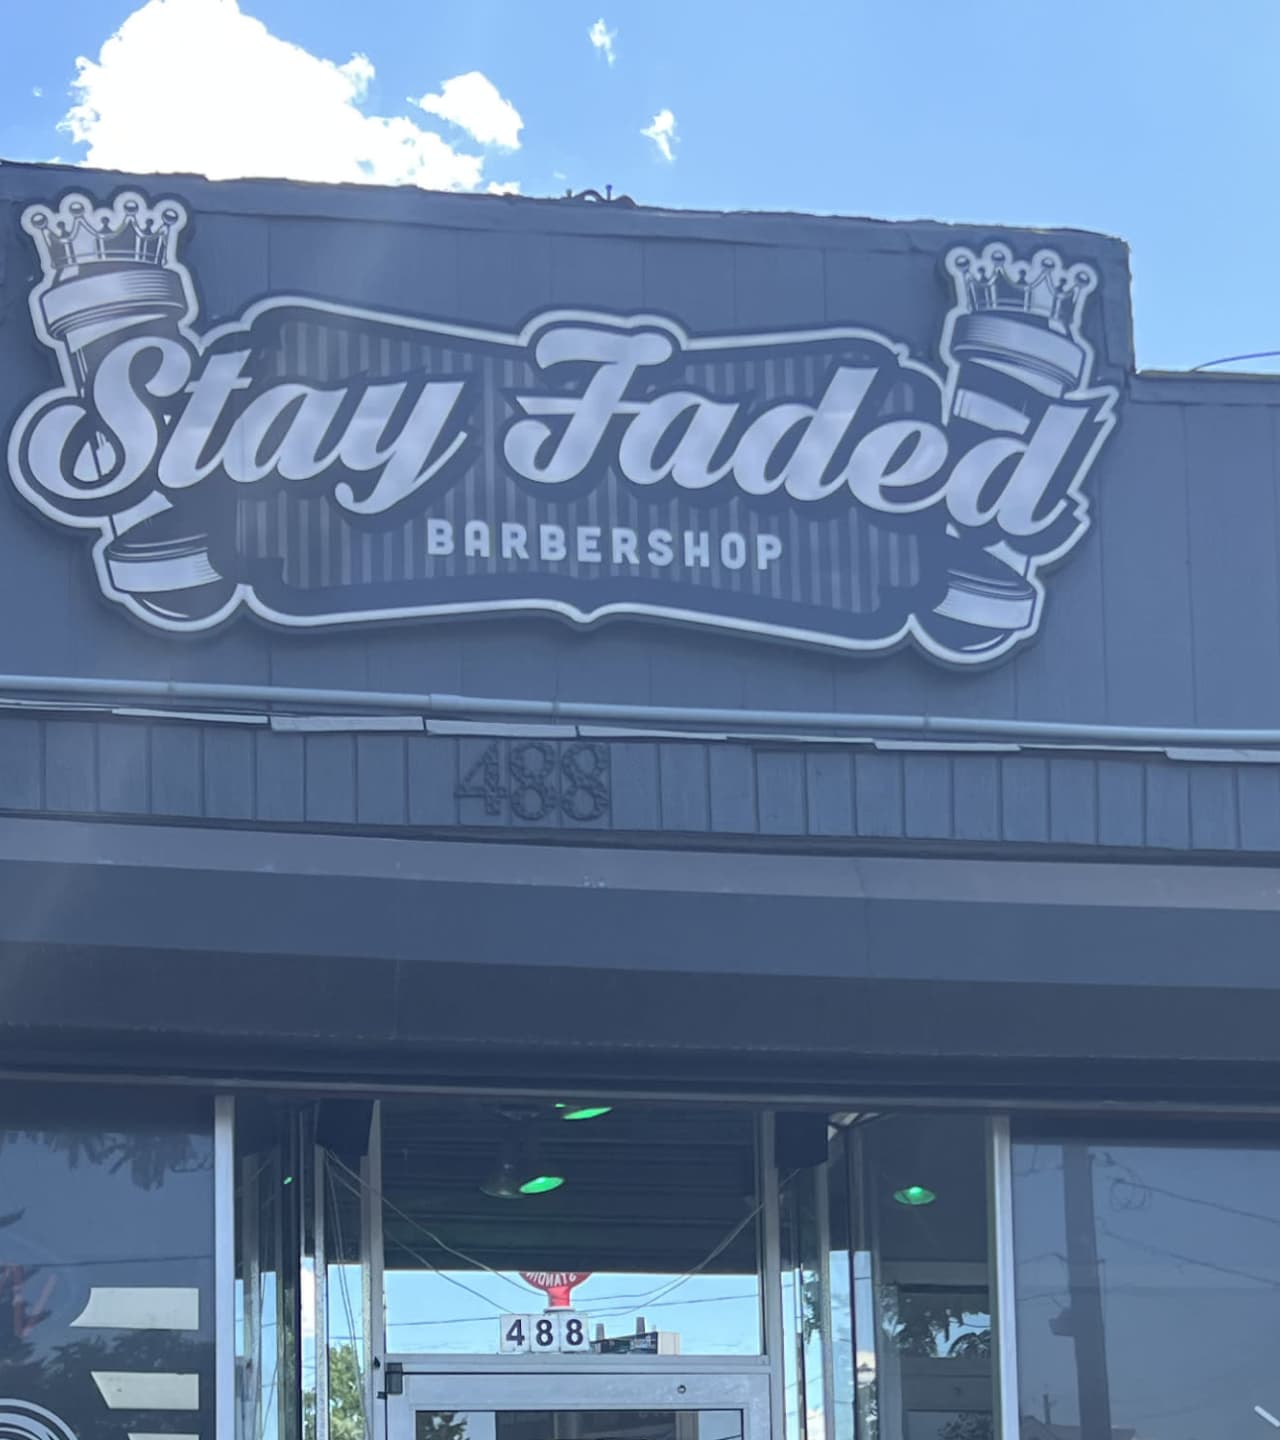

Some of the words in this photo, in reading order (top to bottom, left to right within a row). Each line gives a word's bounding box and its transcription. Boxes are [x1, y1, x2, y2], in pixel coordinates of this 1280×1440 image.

[28, 336, 468, 515] Stay
[504, 327, 1090, 536] Faded
[427, 517, 783, 570] BARBERSHOP
[454, 741, 610, 821] 488
[506, 1319, 583, 1346] 488
